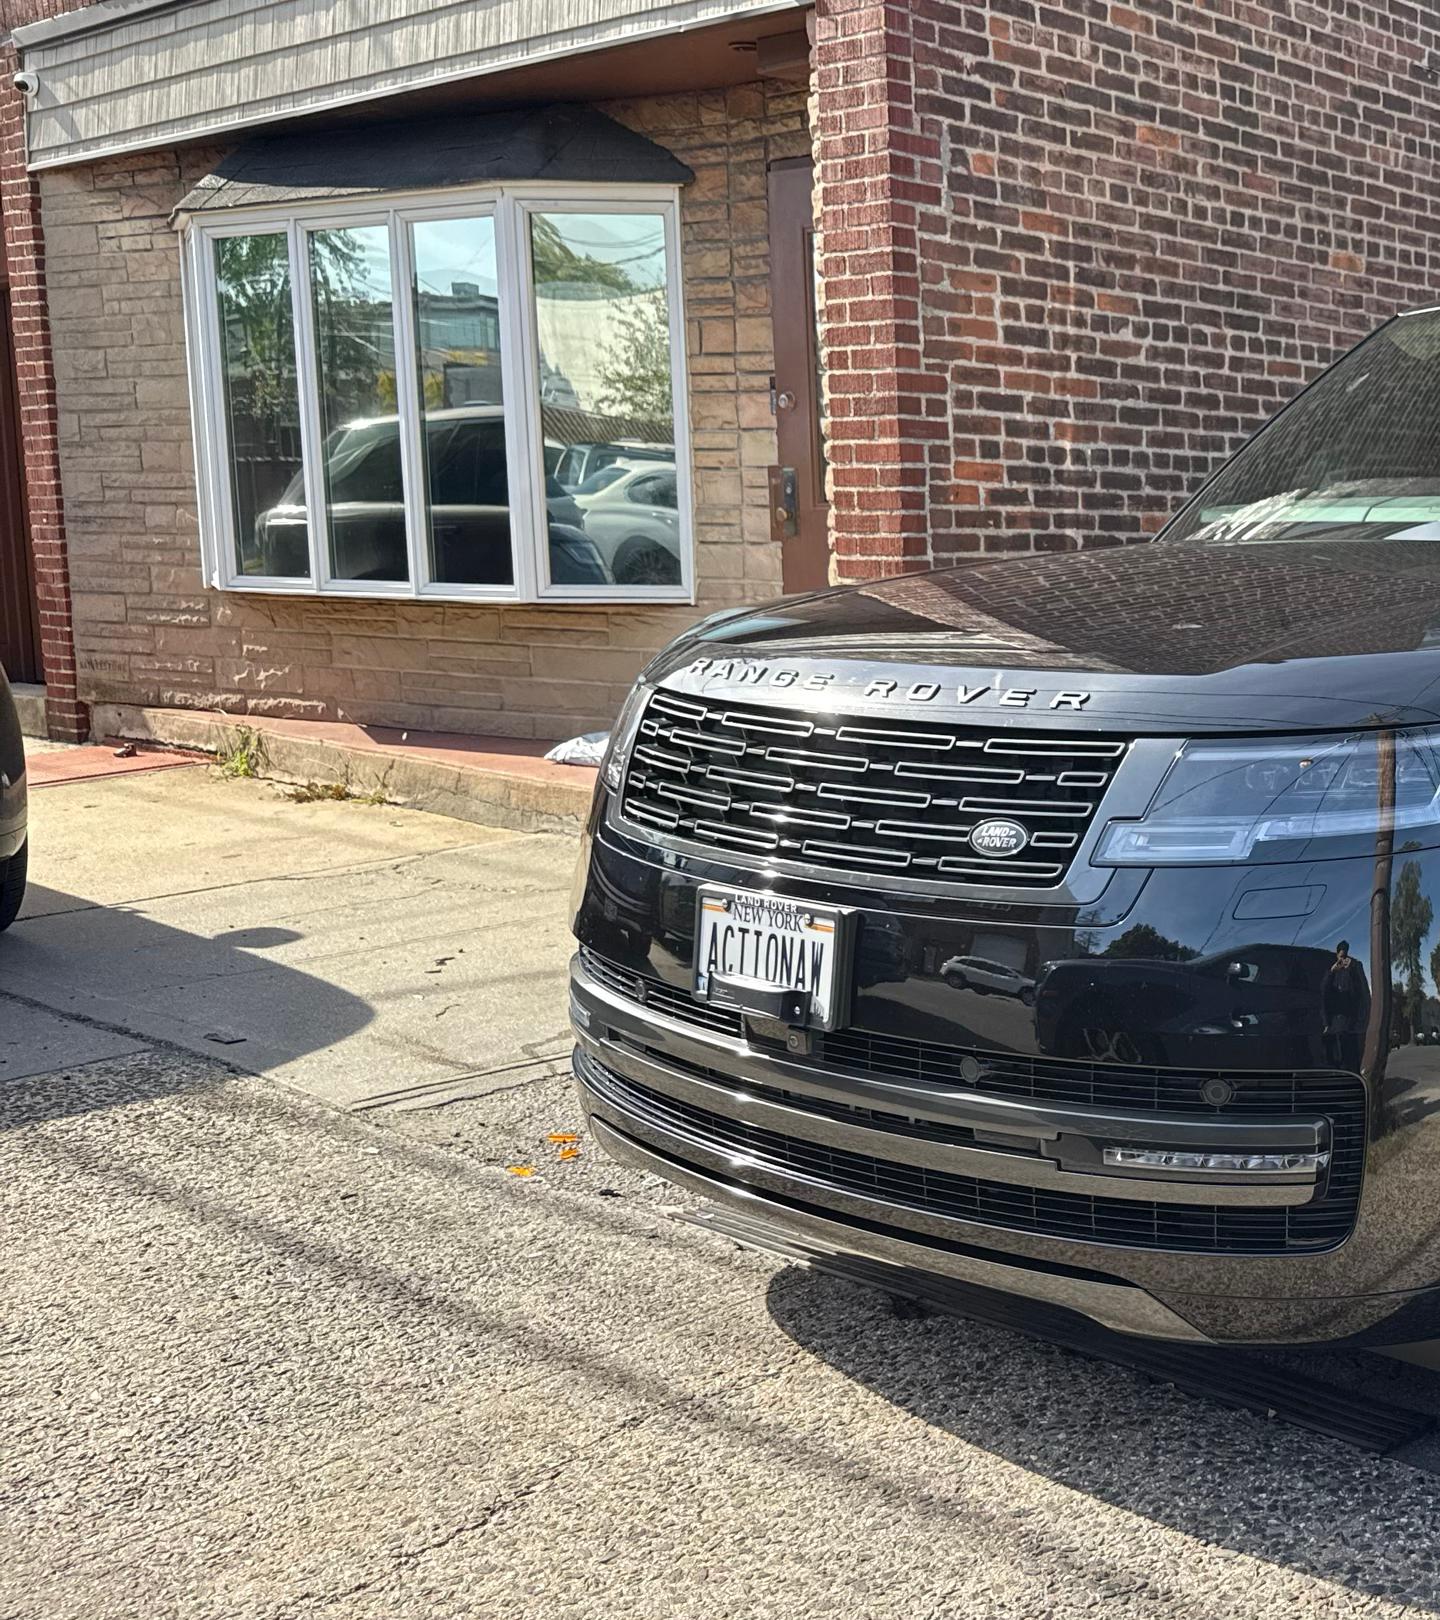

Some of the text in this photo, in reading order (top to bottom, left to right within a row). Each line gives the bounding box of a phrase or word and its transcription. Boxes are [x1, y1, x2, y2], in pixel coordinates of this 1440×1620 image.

[689, 656, 1092, 711] RANGE ROVER
[982, 825, 1009, 837] LAND
[982, 837, 1017, 848] ROVER
[735, 894, 797, 913] LAND ROVER
[733, 904, 804, 933] NEW YORK
